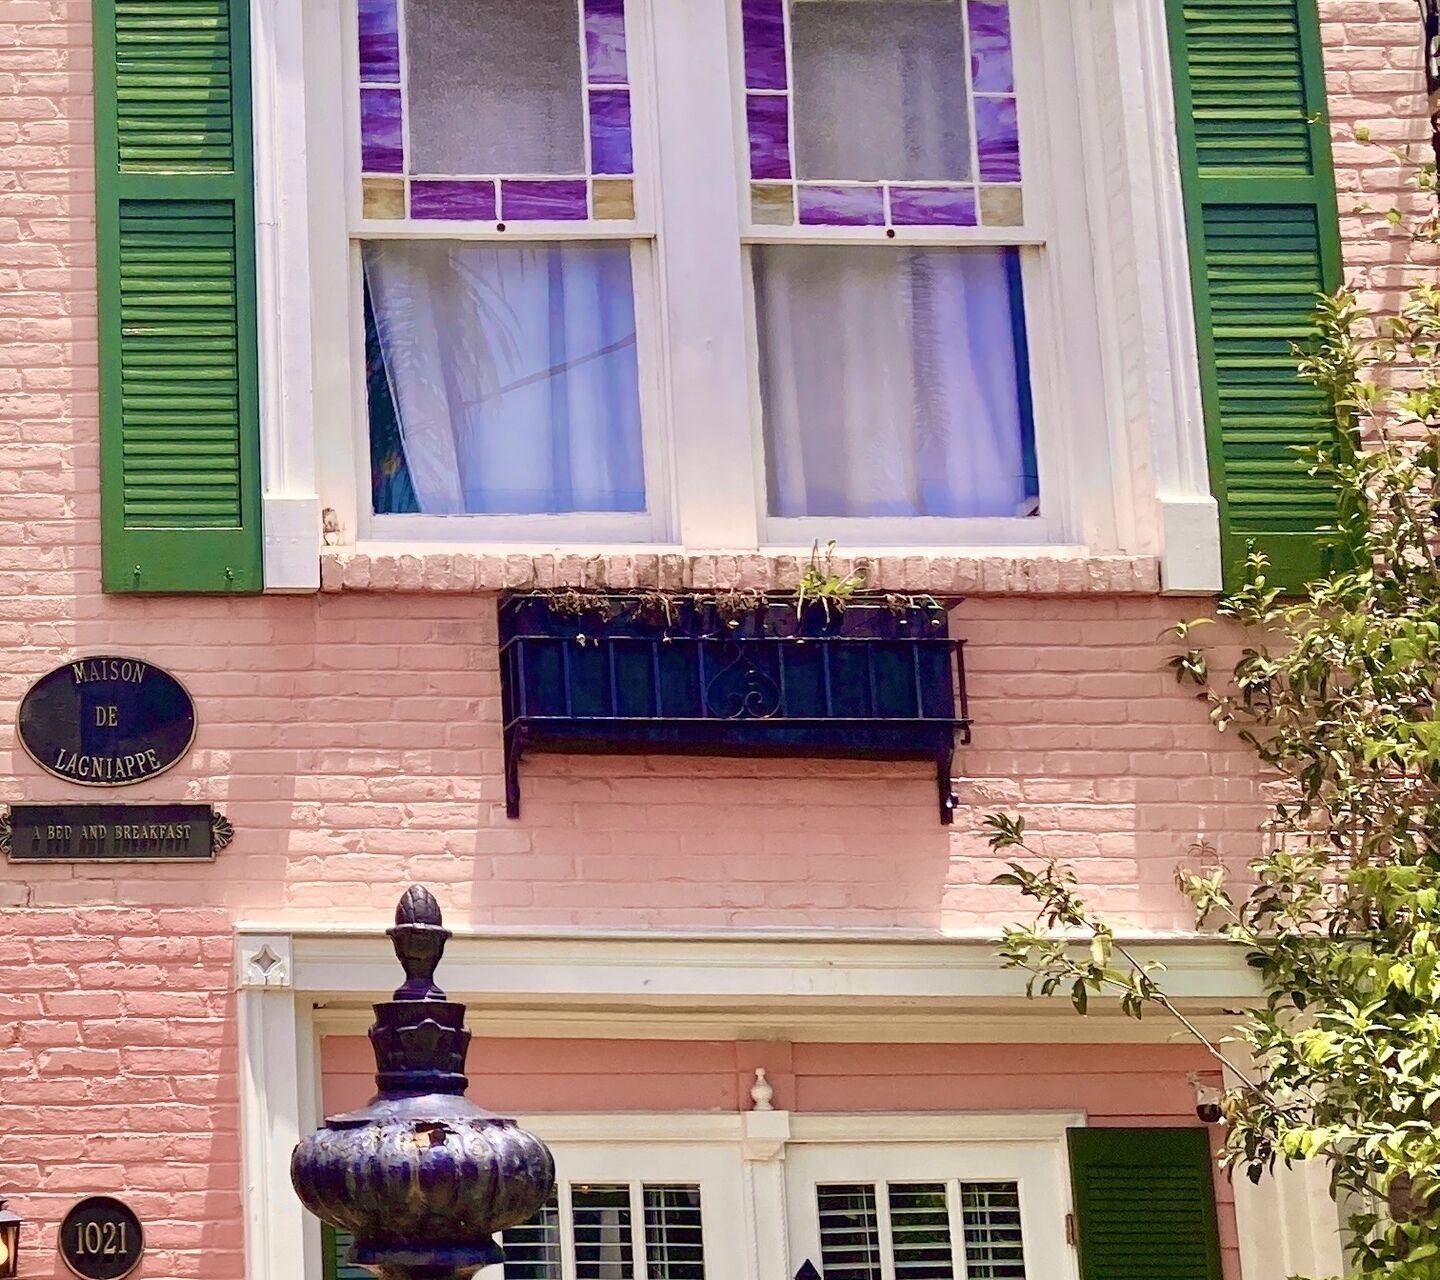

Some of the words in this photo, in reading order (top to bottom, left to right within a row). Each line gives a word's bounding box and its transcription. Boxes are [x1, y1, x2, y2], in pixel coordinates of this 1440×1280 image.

[71, 660, 148, 684] MAISON
[95, 706, 118, 727] DE
[54, 748, 161, 779] LAGNIAPPE
[32, 826, 41, 840] A
[47, 826, 72, 840] BED
[81, 825, 107, 840] AND
[114, 824, 191, 840] BREAKFAST
[75, 1221, 128, 1255] 1021
